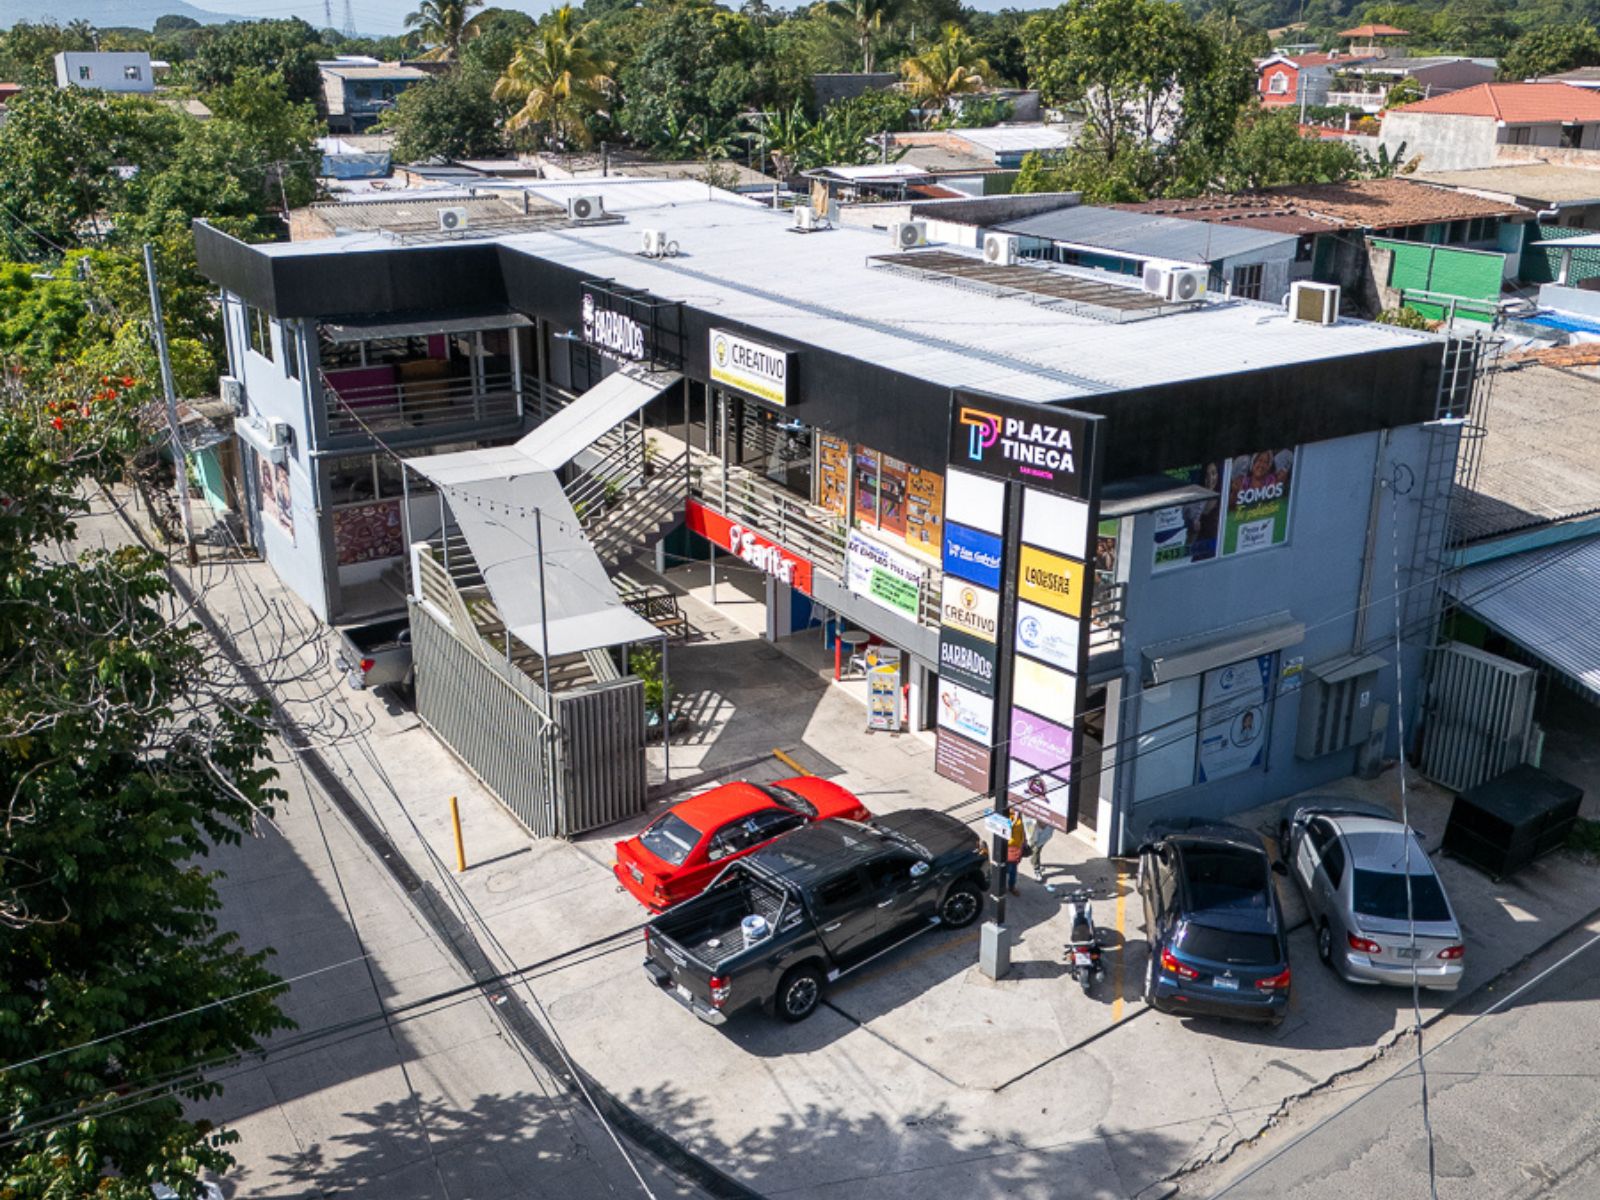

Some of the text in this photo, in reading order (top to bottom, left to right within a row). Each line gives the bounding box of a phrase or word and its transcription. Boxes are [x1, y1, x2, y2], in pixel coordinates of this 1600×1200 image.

[595, 310, 644, 359] BARBADOS
[732, 344, 784, 379] CREATIVO
[1005, 418, 1073, 450] PLAZA
[1000, 438, 1075, 473] TINECA
[1236, 482, 1284, 505] SOMOS
[741, 532, 796, 584] Sarita
[945, 604, 995, 633] CREATIVO
[942, 642, 993, 679] BARBADOS
